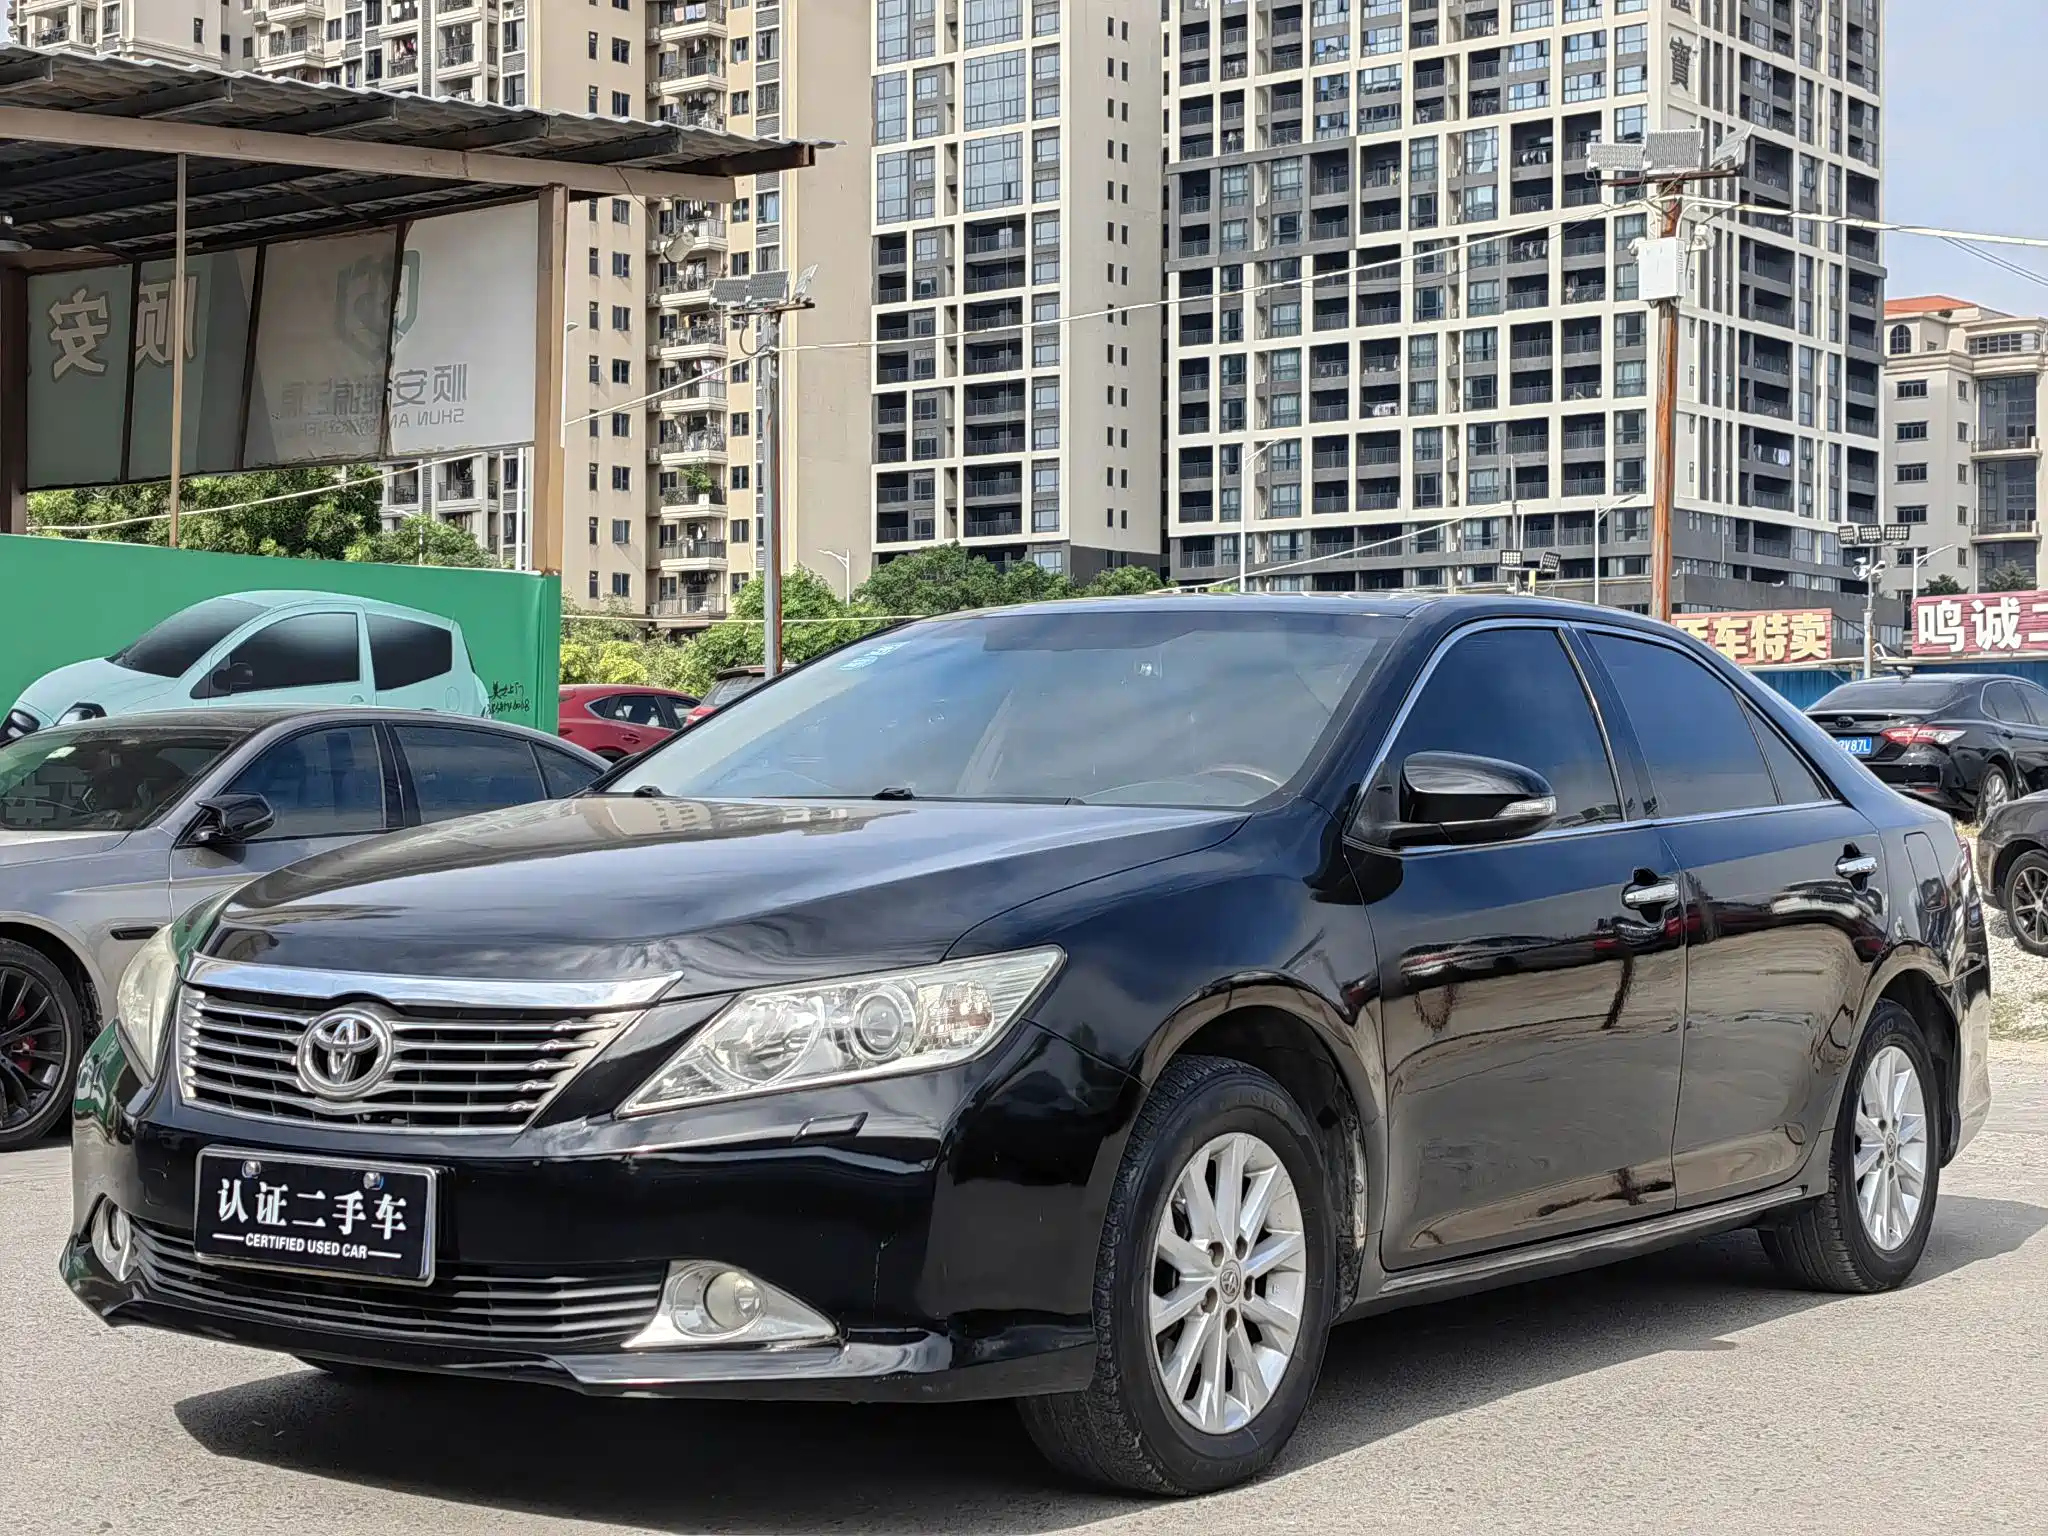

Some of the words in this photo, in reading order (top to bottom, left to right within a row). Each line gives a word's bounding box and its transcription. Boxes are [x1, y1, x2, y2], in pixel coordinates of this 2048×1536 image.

[217, 1177, 407, 1241] 认证二手车
[245, 1232, 305, 1252] CERTIFIED
[307, 1239, 340, 1256] USED
[342, 1243, 368, 1259] CAR
